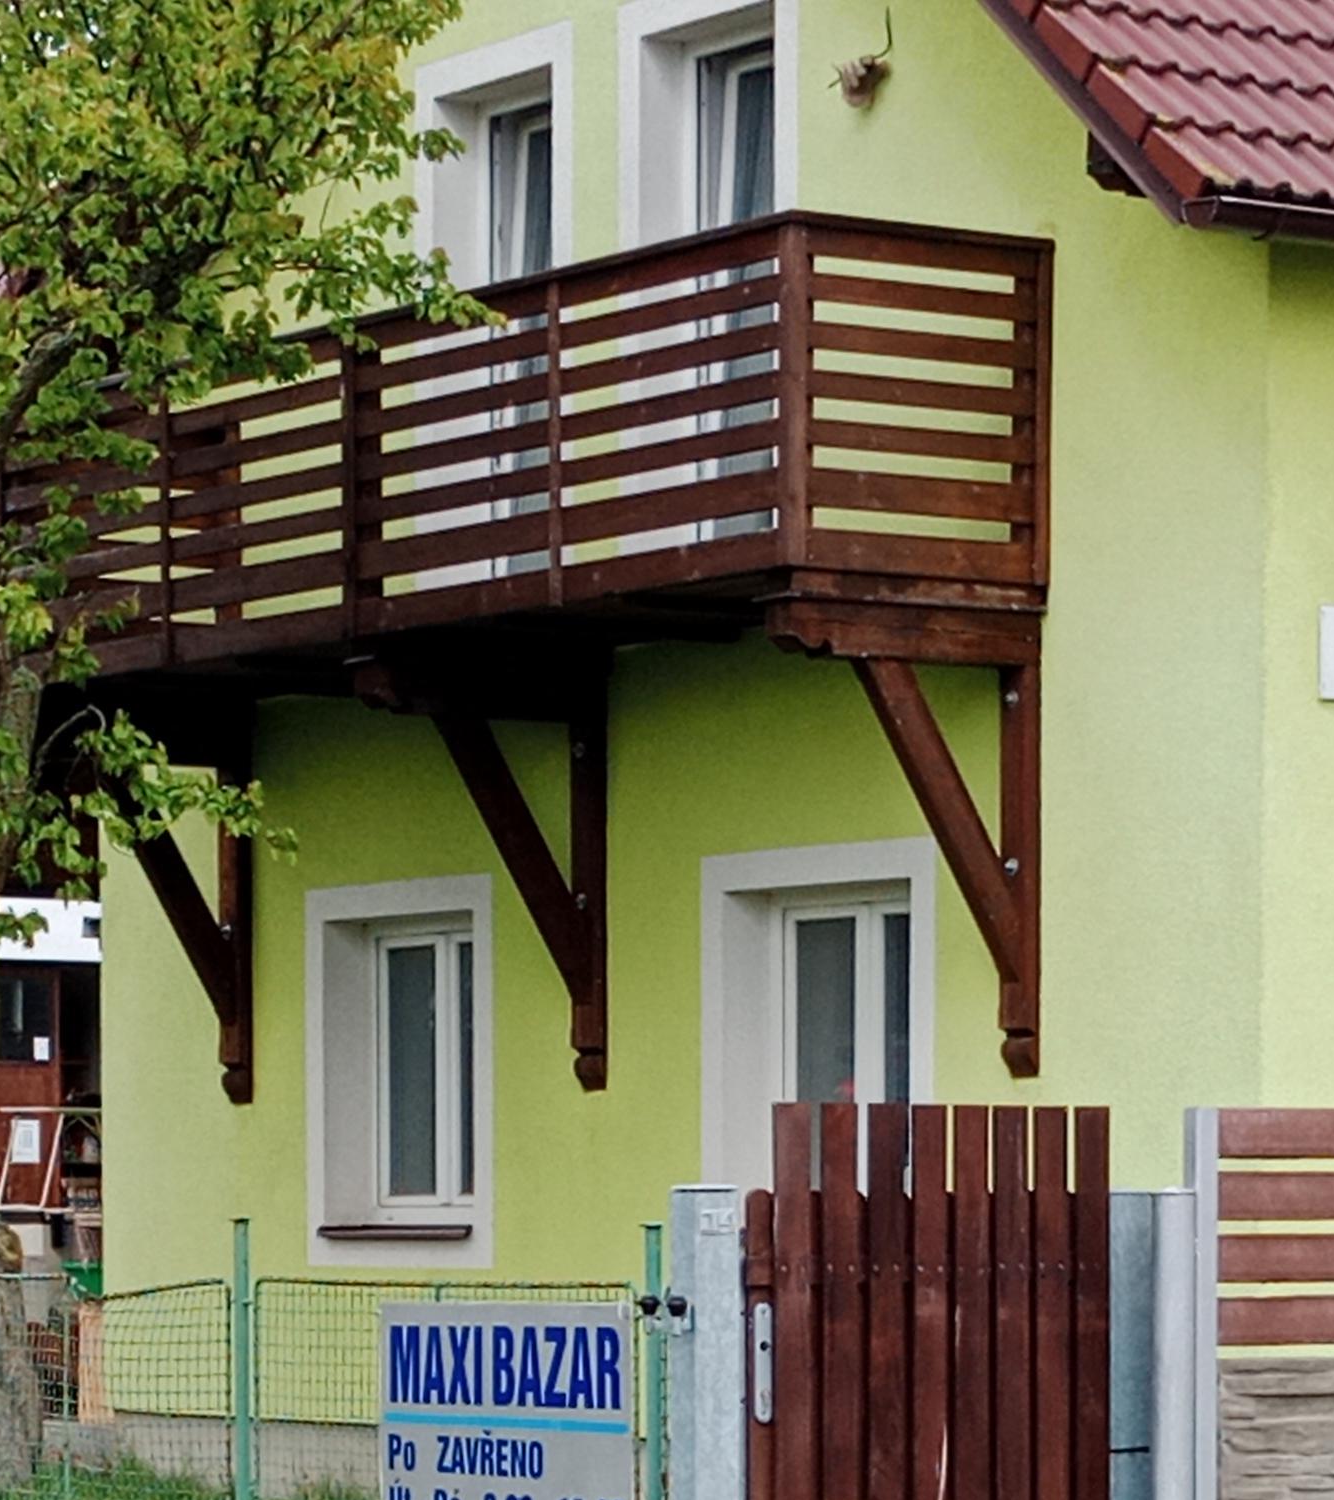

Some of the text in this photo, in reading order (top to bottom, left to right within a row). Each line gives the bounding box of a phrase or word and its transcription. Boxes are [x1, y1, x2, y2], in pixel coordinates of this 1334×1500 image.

[389, 1324, 622, 1411] MAXI BAZAR
[387, 1428, 544, 1480] Po ZAVŘENO
